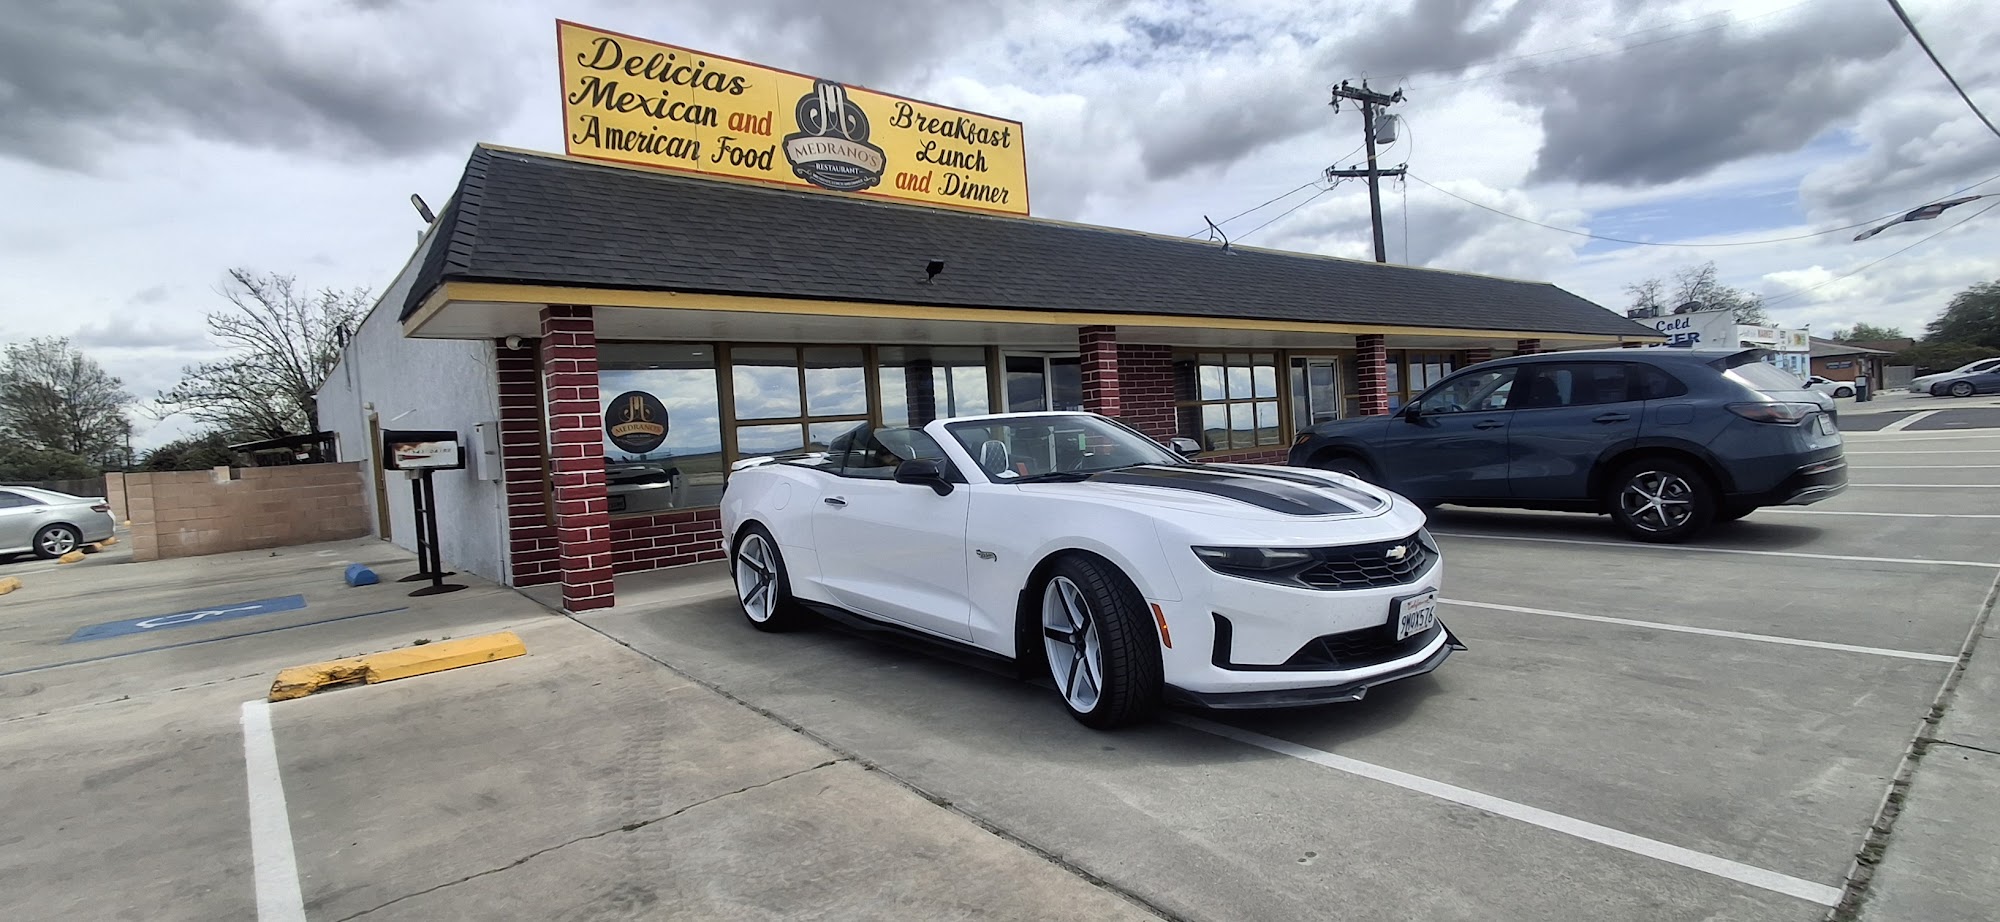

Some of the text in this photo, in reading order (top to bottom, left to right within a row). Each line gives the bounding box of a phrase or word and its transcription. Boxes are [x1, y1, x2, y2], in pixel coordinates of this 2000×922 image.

[577, 37, 752, 95] Delicias
[568, 76, 773, 136] Mexican and
[572, 114, 776, 171] American Food
[794, 142, 878, 167] MEDRANO'S
[916, 139, 988, 172] Lunch
[815, 163, 859, 174] RESTAURANT
[895, 170, 933, 194] and
[938, 172, 1009, 204] Dinner
[1656, 317, 1691, 332] Cold
